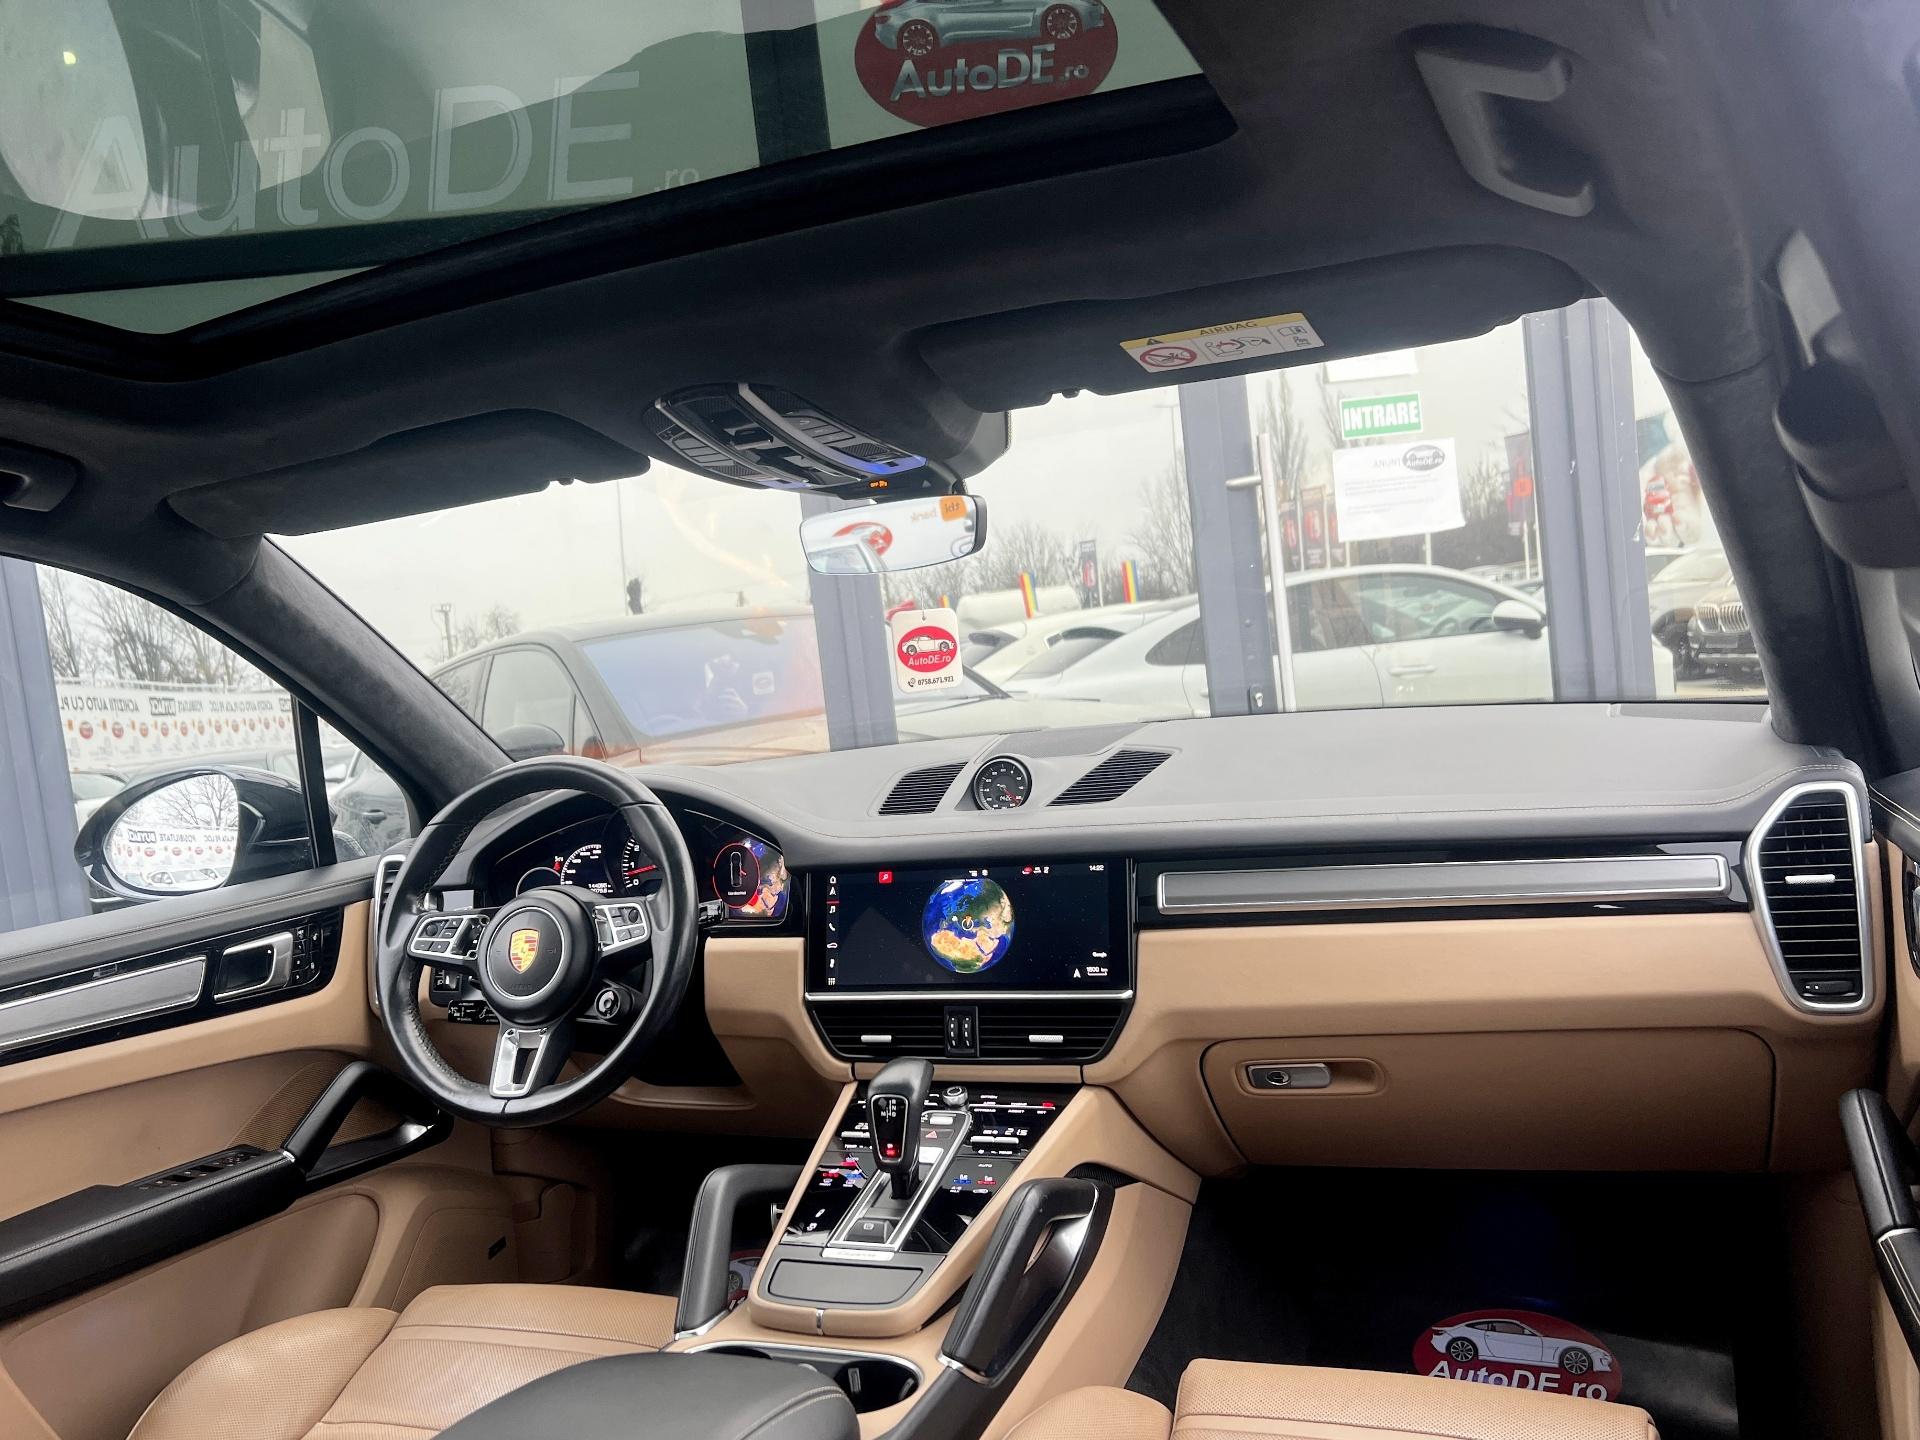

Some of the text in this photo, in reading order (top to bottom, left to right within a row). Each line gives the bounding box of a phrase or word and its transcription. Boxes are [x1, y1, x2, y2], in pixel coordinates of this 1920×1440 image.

[1200, 321, 1258, 336] AIRBAG
[1343, 401, 1420, 431] INTRARE
[908, 655, 952, 667] AutoDE.ro
[917, 676, 954, 686] 0758.671.921
[630, 861, 635, 869] 1
[633, 878, 639, 886] 0
